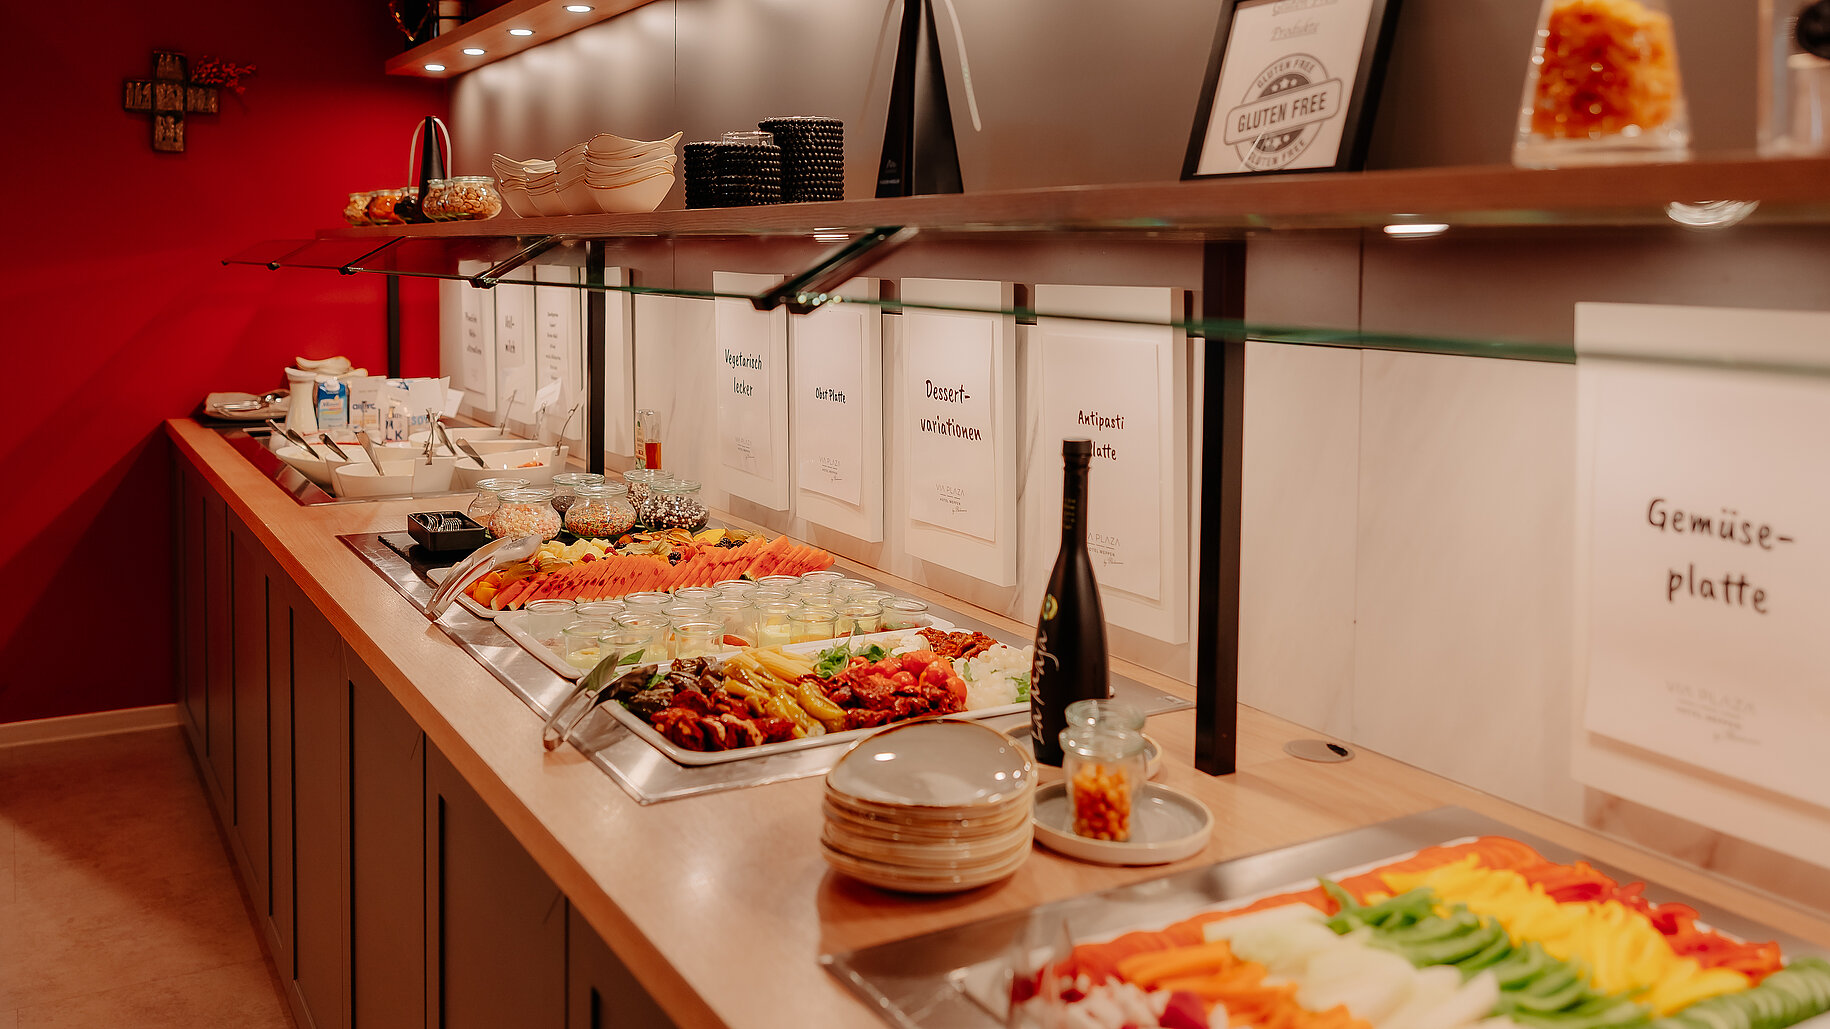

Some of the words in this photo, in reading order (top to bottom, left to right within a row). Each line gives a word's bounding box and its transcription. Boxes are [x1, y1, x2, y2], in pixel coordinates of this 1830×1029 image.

[1257, 61, 1290, 88] GLUTEN
[1294, 59, 1315, 74] FREE
[1237, 105, 1287, 132] GLUTEN
[1292, 92, 1327, 119] FREE
[724, 349, 763, 370] Vegetarisch
[733, 377, 753, 397] lecker
[815, 387, 828, 400] Obst
[828, 389, 847, 404] Platte
[925, 379, 971, 404] Dessert-
[920, 415, 982, 441] variationen
[1078, 409, 1125, 431] Antipasti
[1089, 440, 1117, 461] latte
[935, 483, 945, 491] VIA
[946, 485, 965, 496] PLAZA
[1648, 498, 1793, 550] Gemüse-
[1095, 533, 1121, 547] PLAZA
[1666, 562, 1769, 615] platte
